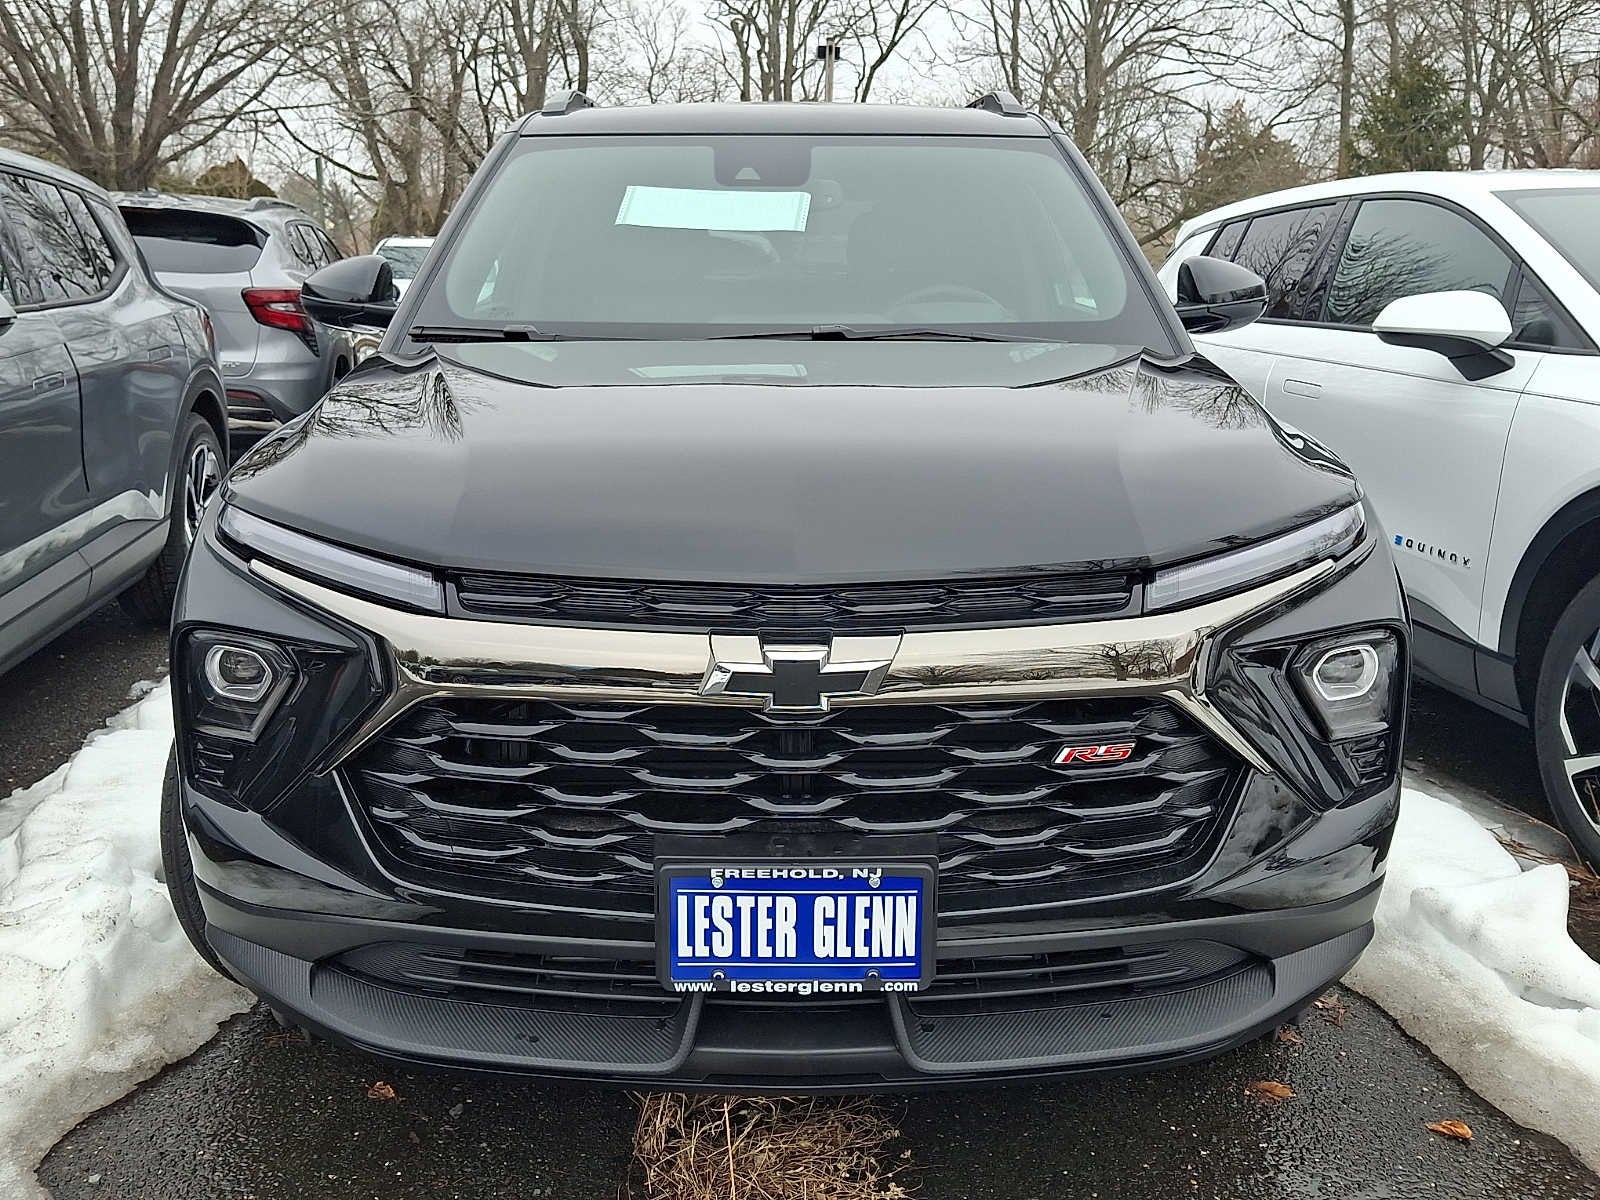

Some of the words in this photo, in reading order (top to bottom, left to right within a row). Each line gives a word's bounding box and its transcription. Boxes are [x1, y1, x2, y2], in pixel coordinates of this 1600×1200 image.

[1394, 534, 1471, 568] EQUINOX
[1054, 743, 1136, 763] RS
[710, 868, 845, 880] FREEHOLD,
[852, 868, 882, 879] NJ
[677, 895, 797, 958] LESTER
[813, 895, 917, 958] GLENN
[674, 982, 717, 992] www.
[730, 980, 863, 995] lesterglenn
[880, 981, 919, 992] .com
